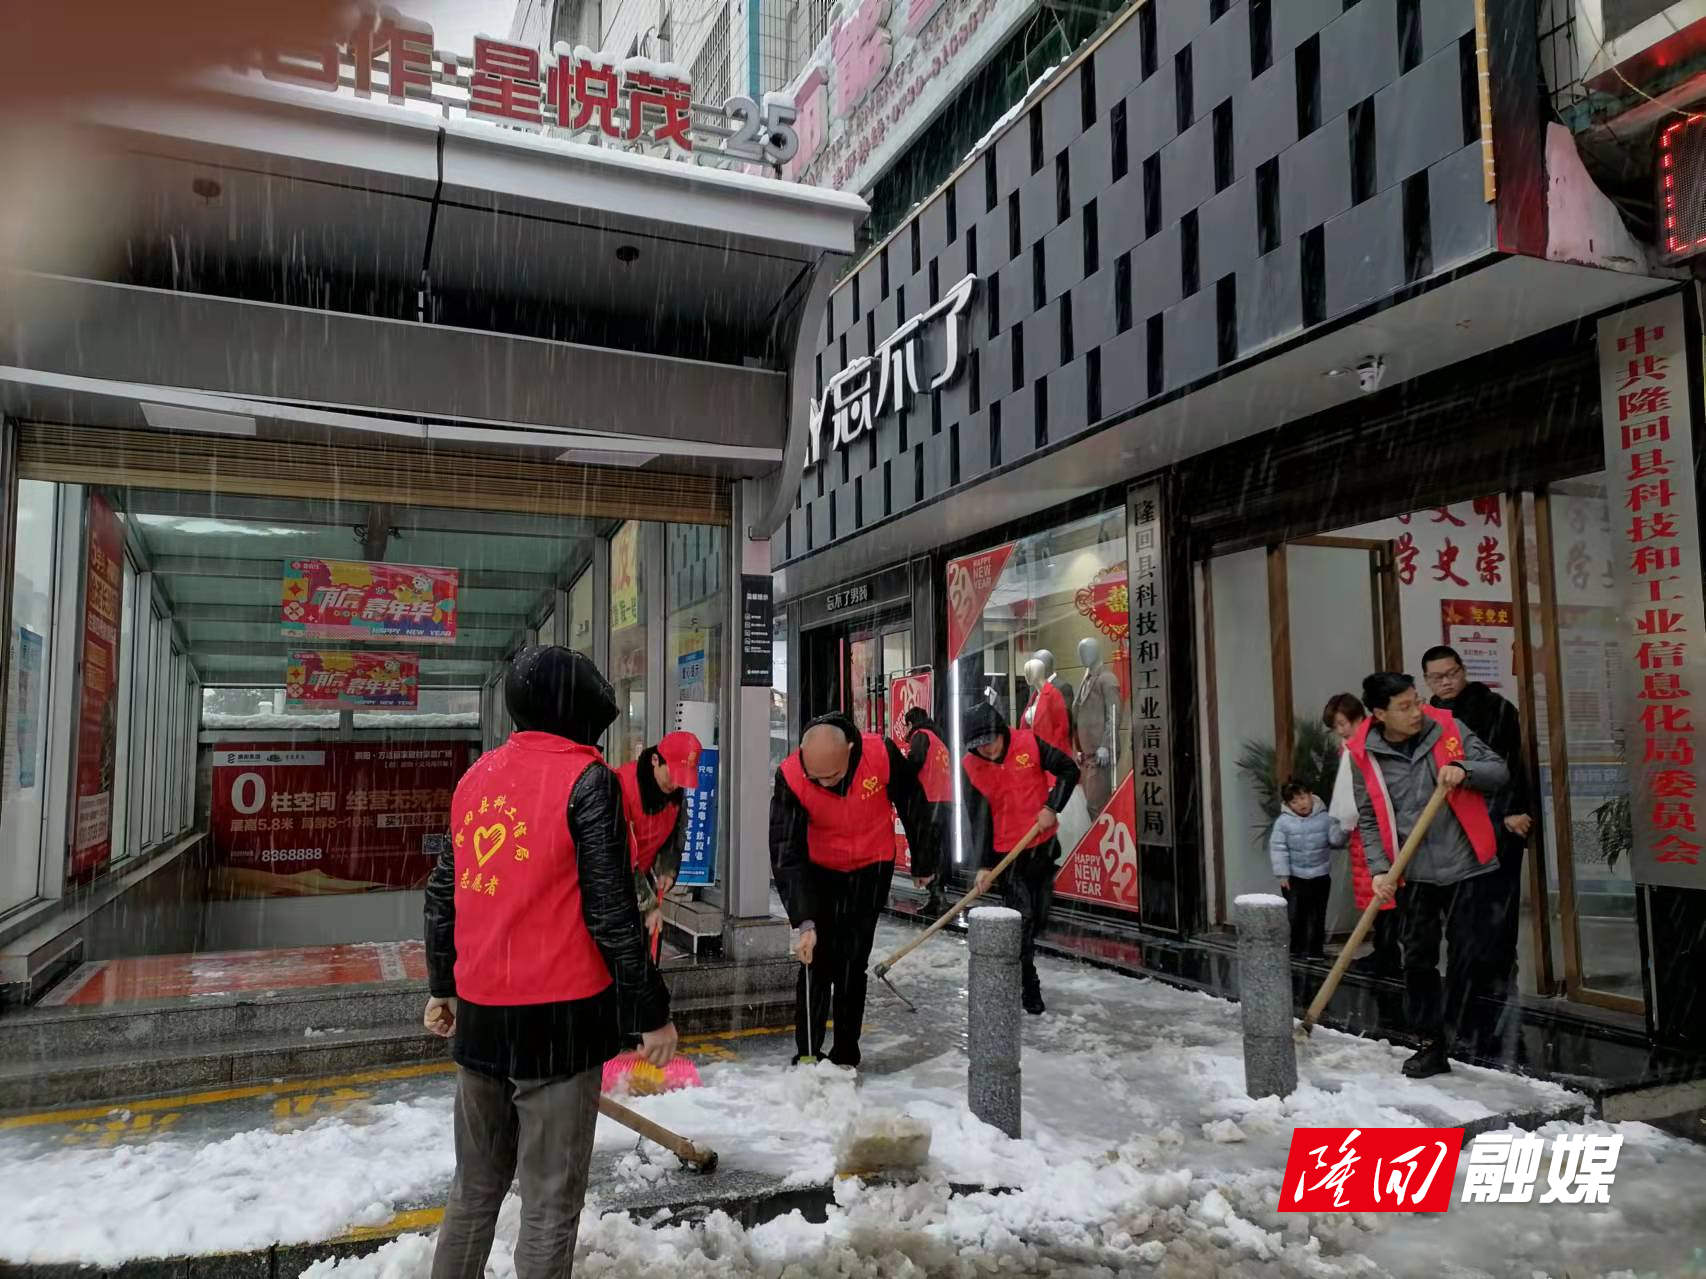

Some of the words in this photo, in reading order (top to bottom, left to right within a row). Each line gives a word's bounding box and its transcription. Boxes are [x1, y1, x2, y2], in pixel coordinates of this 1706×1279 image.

[723, 96, 798, 164] 25
[973, 557, 991, 567] HAPPY
[974, 566, 991, 579] NEW
[974, 577, 992, 590] YEAR
[1615, 325, 1705, 865] 中共隆回县科技和工业信息化局委员会
[1134, 500, 1165, 836] 隆回县科技和工业信息化局
[1074, 852, 1101, 867] HAPPY
[1074, 864, 1101, 881] NEW
[1075, 880, 1102, 897] YEAR
